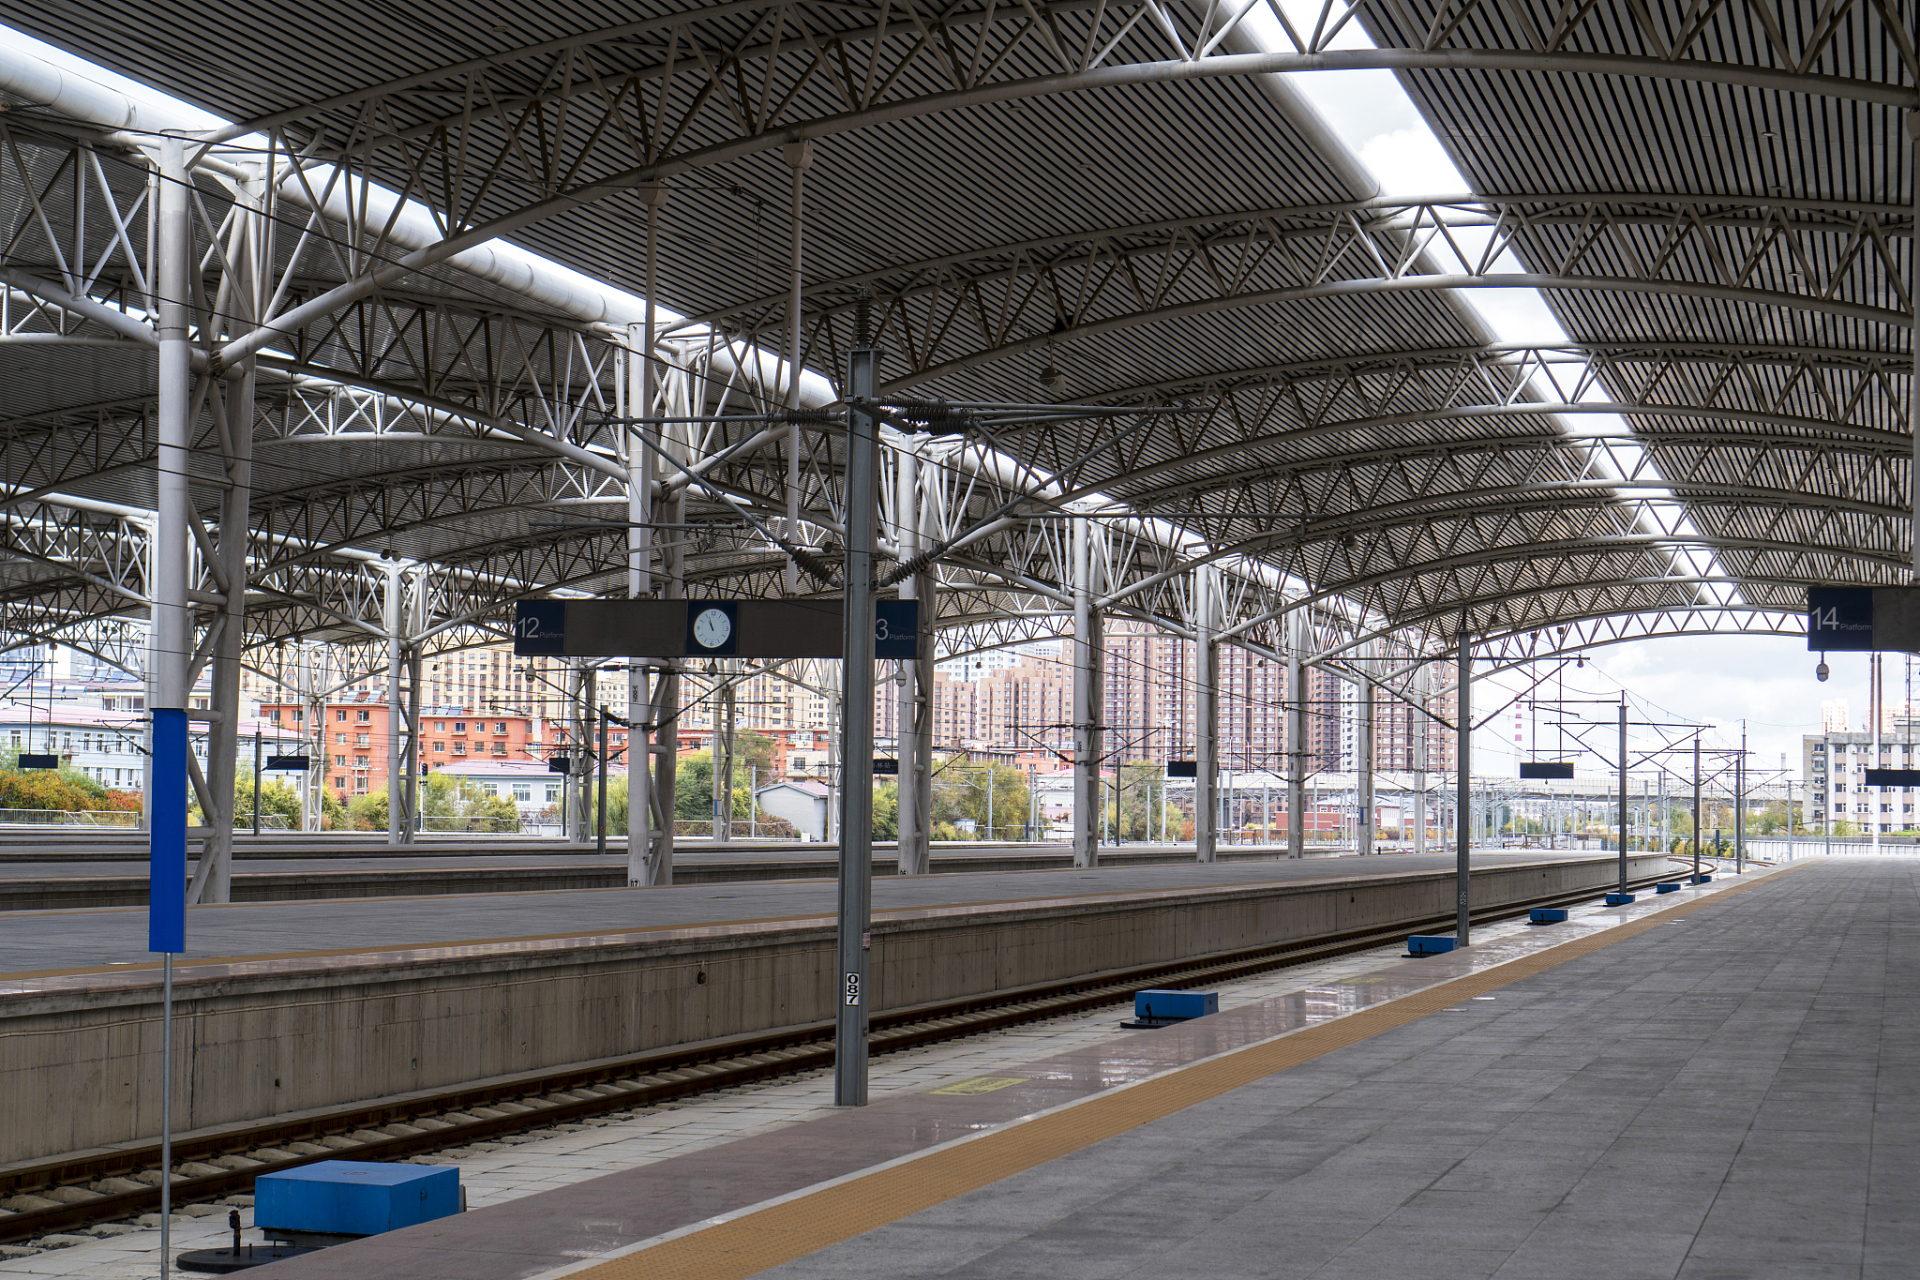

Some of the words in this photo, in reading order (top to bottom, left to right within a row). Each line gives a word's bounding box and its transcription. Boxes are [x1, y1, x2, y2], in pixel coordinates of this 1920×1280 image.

[518, 616, 540, 638] 12
[1811, 606, 1839, 630] 14
[630, 879, 639, 888] 07
[847, 974, 859, 1004] 087
